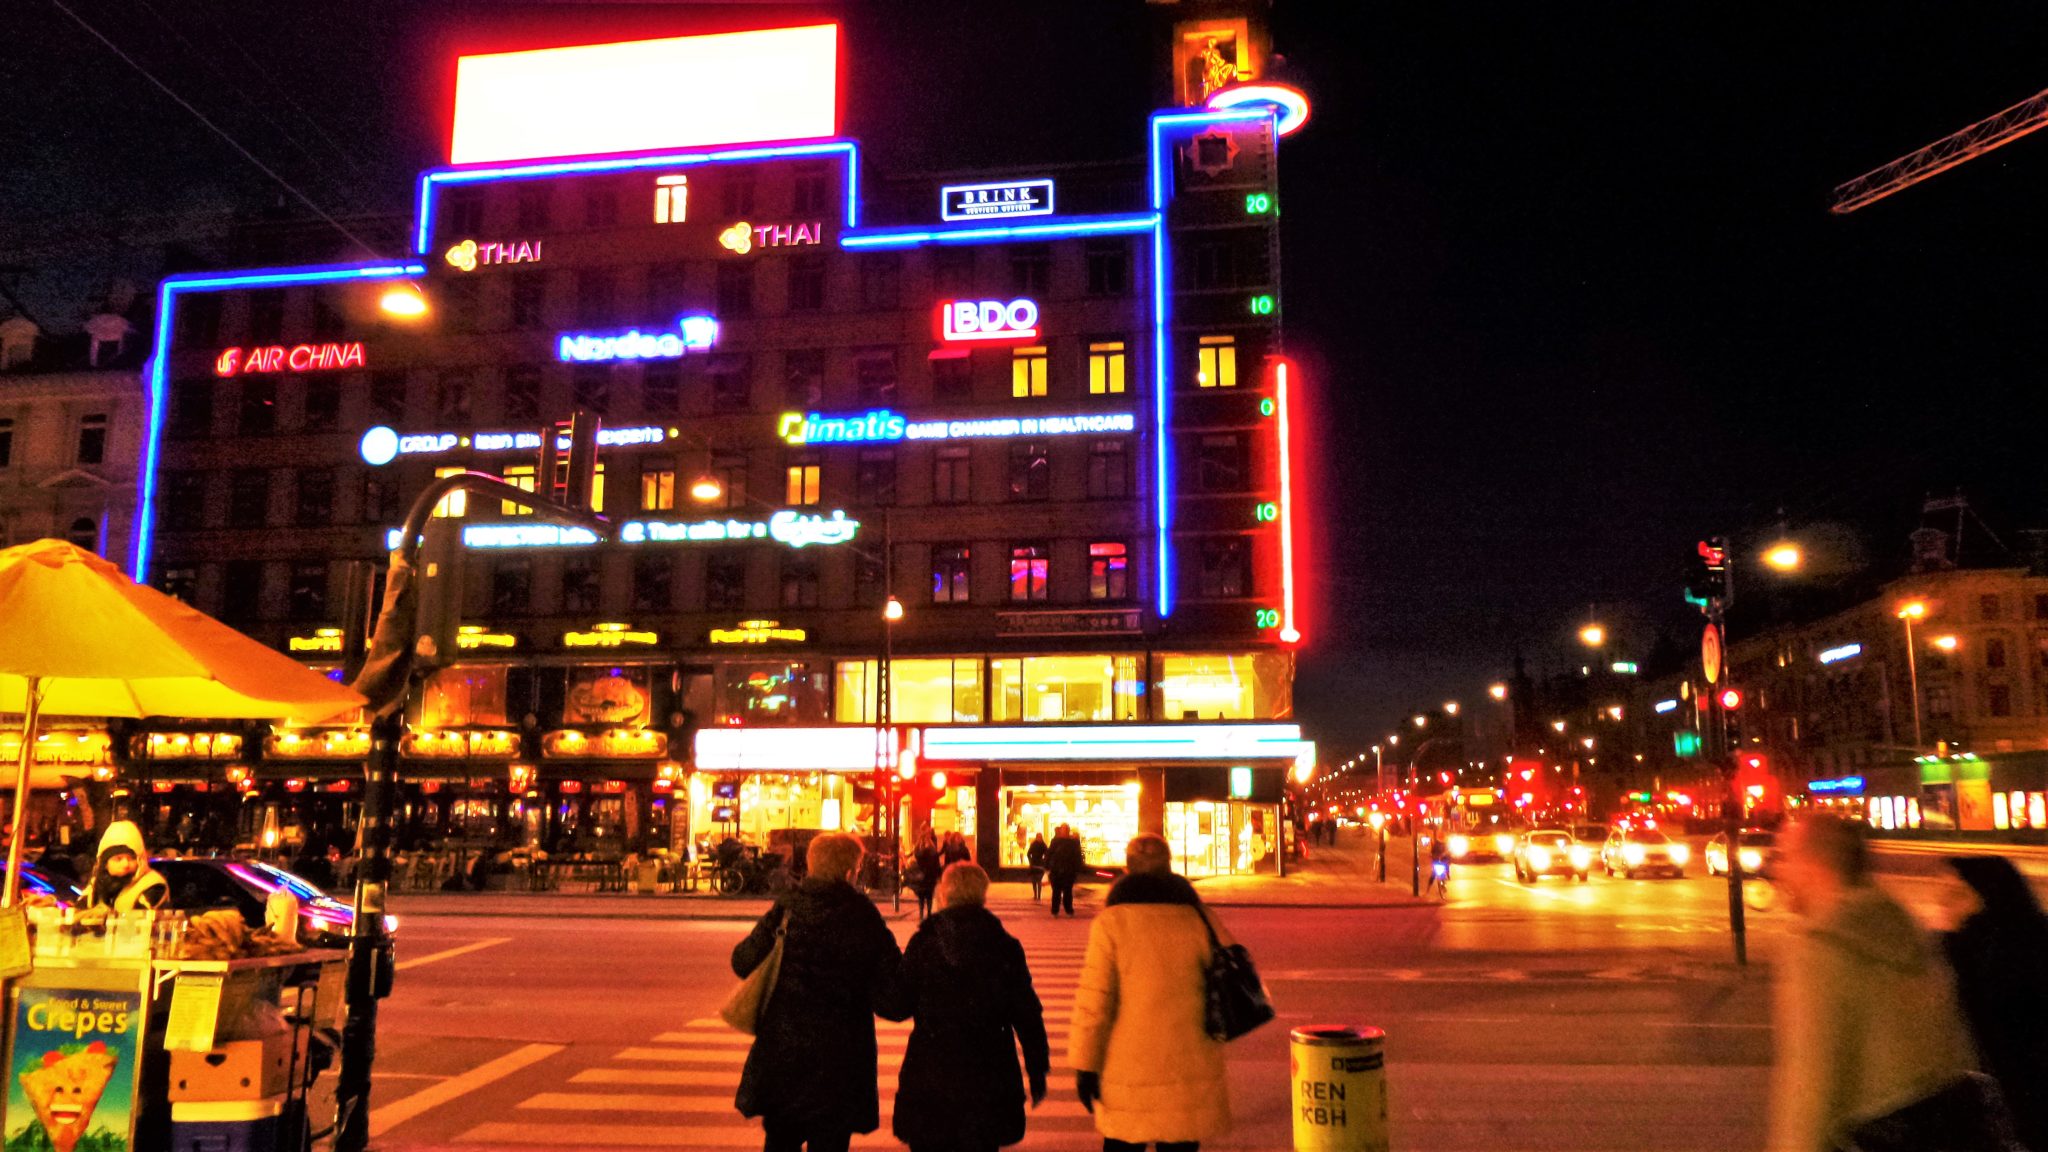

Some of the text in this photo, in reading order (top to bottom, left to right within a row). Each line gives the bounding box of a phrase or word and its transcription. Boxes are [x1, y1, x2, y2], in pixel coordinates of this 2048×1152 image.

[965, 187, 1030, 204] BRINK
[1246, 194, 1269, 213] 20
[754, 223, 820, 247] THAI
[479, 241, 541, 264] THAI
[1251, 295, 1274, 314] 10
[953, 299, 1038, 333] BDO
[559, 329, 684, 361] Nordea
[244, 342, 365, 373] AIR CHINA
[1260, 398, 1275, 416] 0
[1021, 417, 1038, 435] IN
[1039, 414, 1134, 434] HEALTHCARE
[400, 434, 457, 453] GROUP
[1256, 502, 1278, 522] 10
[1256, 608, 1279, 628] 20
[27, 1002, 129, 1039] Crepes
[1301, 1081, 1346, 1101] REN
[1301, 1104, 1347, 1128] KBH
